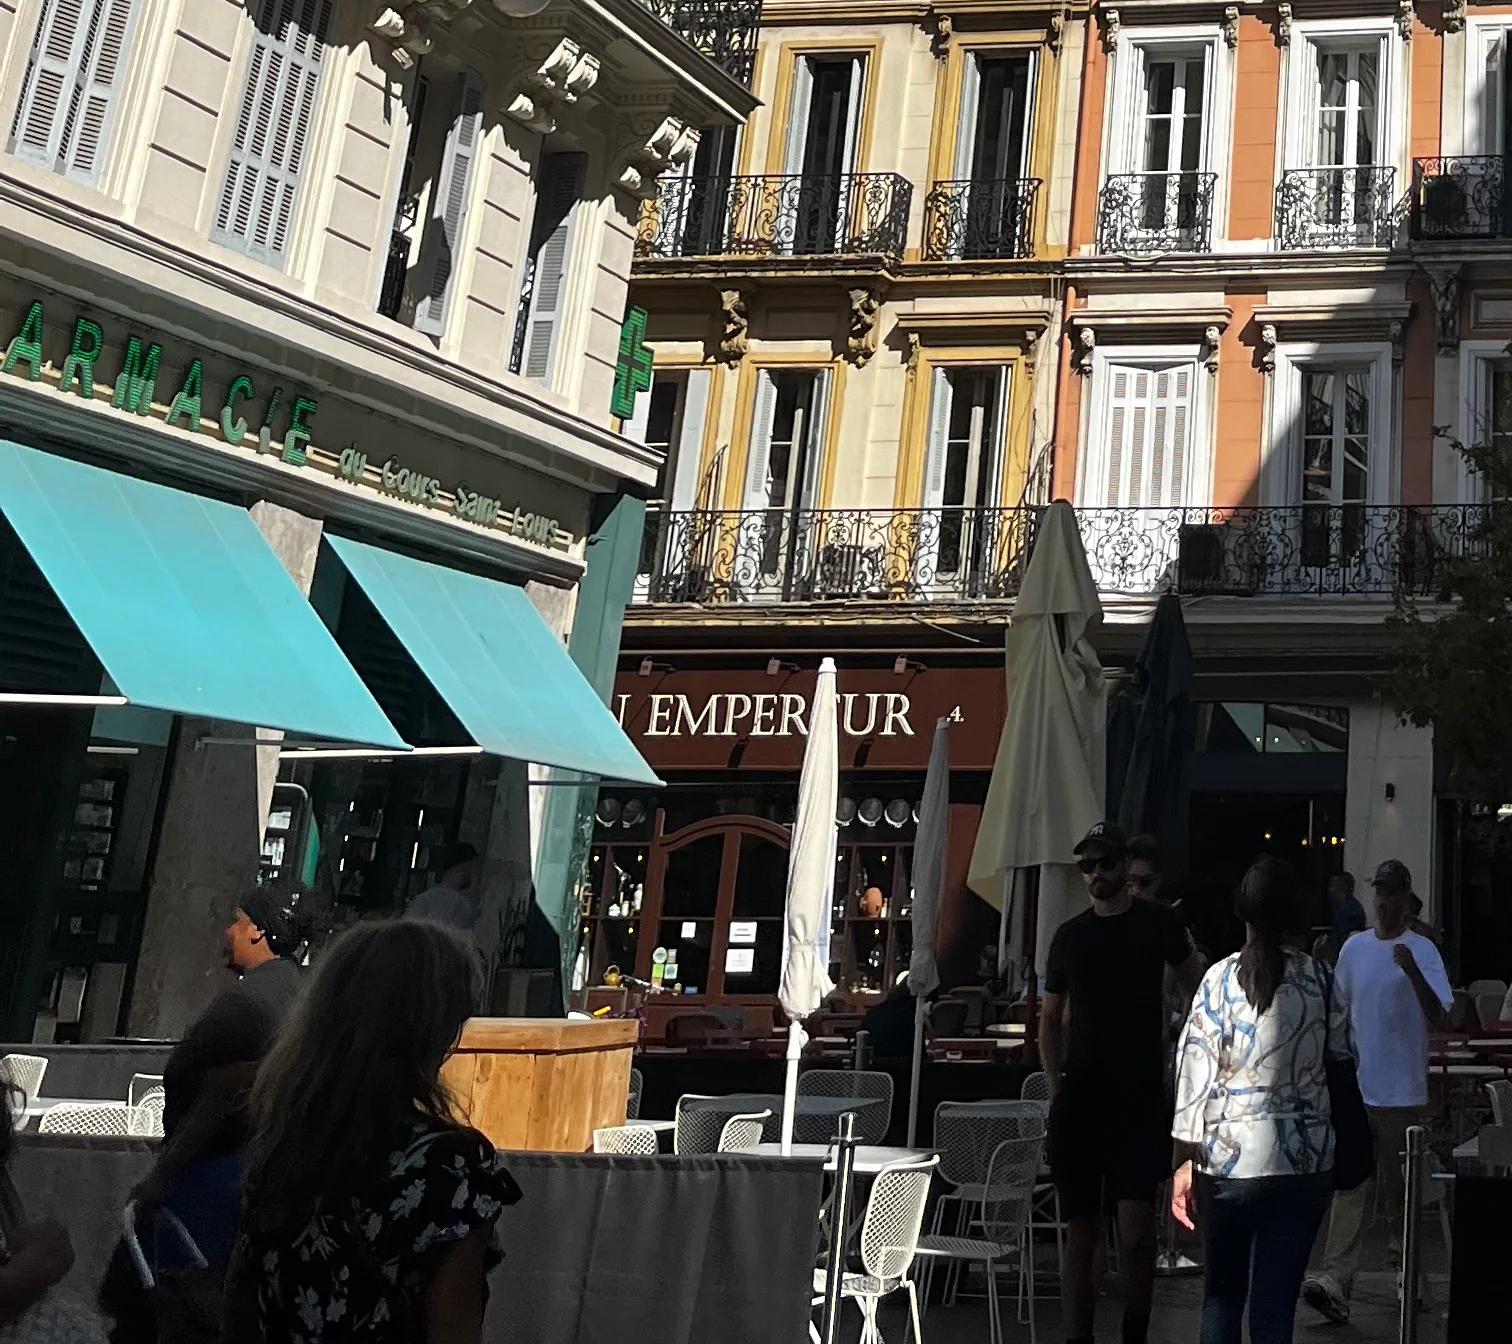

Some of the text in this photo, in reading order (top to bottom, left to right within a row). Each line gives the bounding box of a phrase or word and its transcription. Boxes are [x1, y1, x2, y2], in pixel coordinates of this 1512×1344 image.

[0, 298, 559, 543] ARMACIE du Cours Saint Louis
[643, 693, 915, 736] EMPERUR
